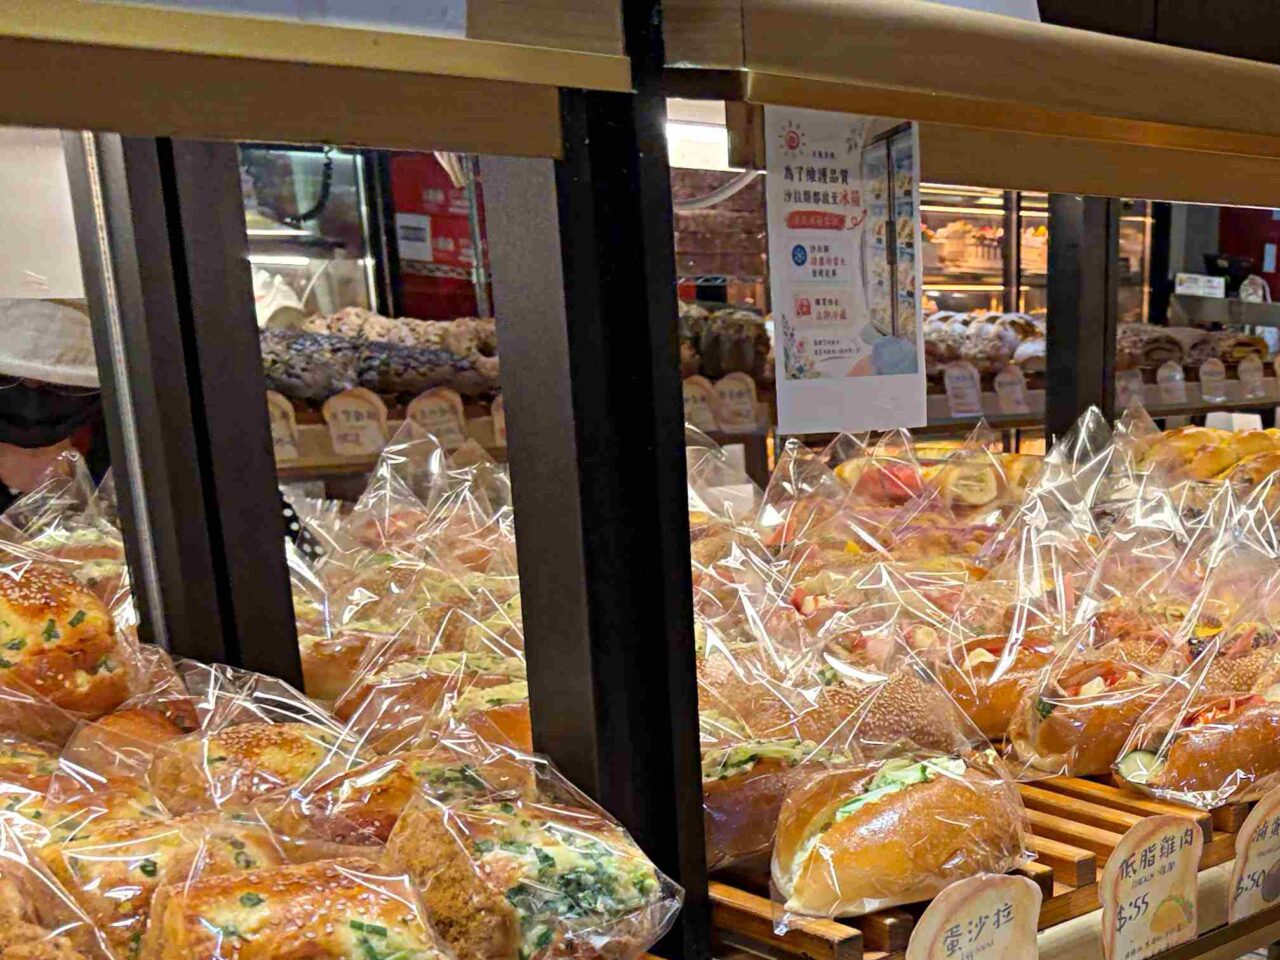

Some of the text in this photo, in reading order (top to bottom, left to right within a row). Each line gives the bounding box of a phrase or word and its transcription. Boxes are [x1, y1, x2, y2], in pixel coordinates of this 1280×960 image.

[783, 164, 849, 185] 為了維護品質
[1119, 827, 1195, 881] 低脂雞肉
